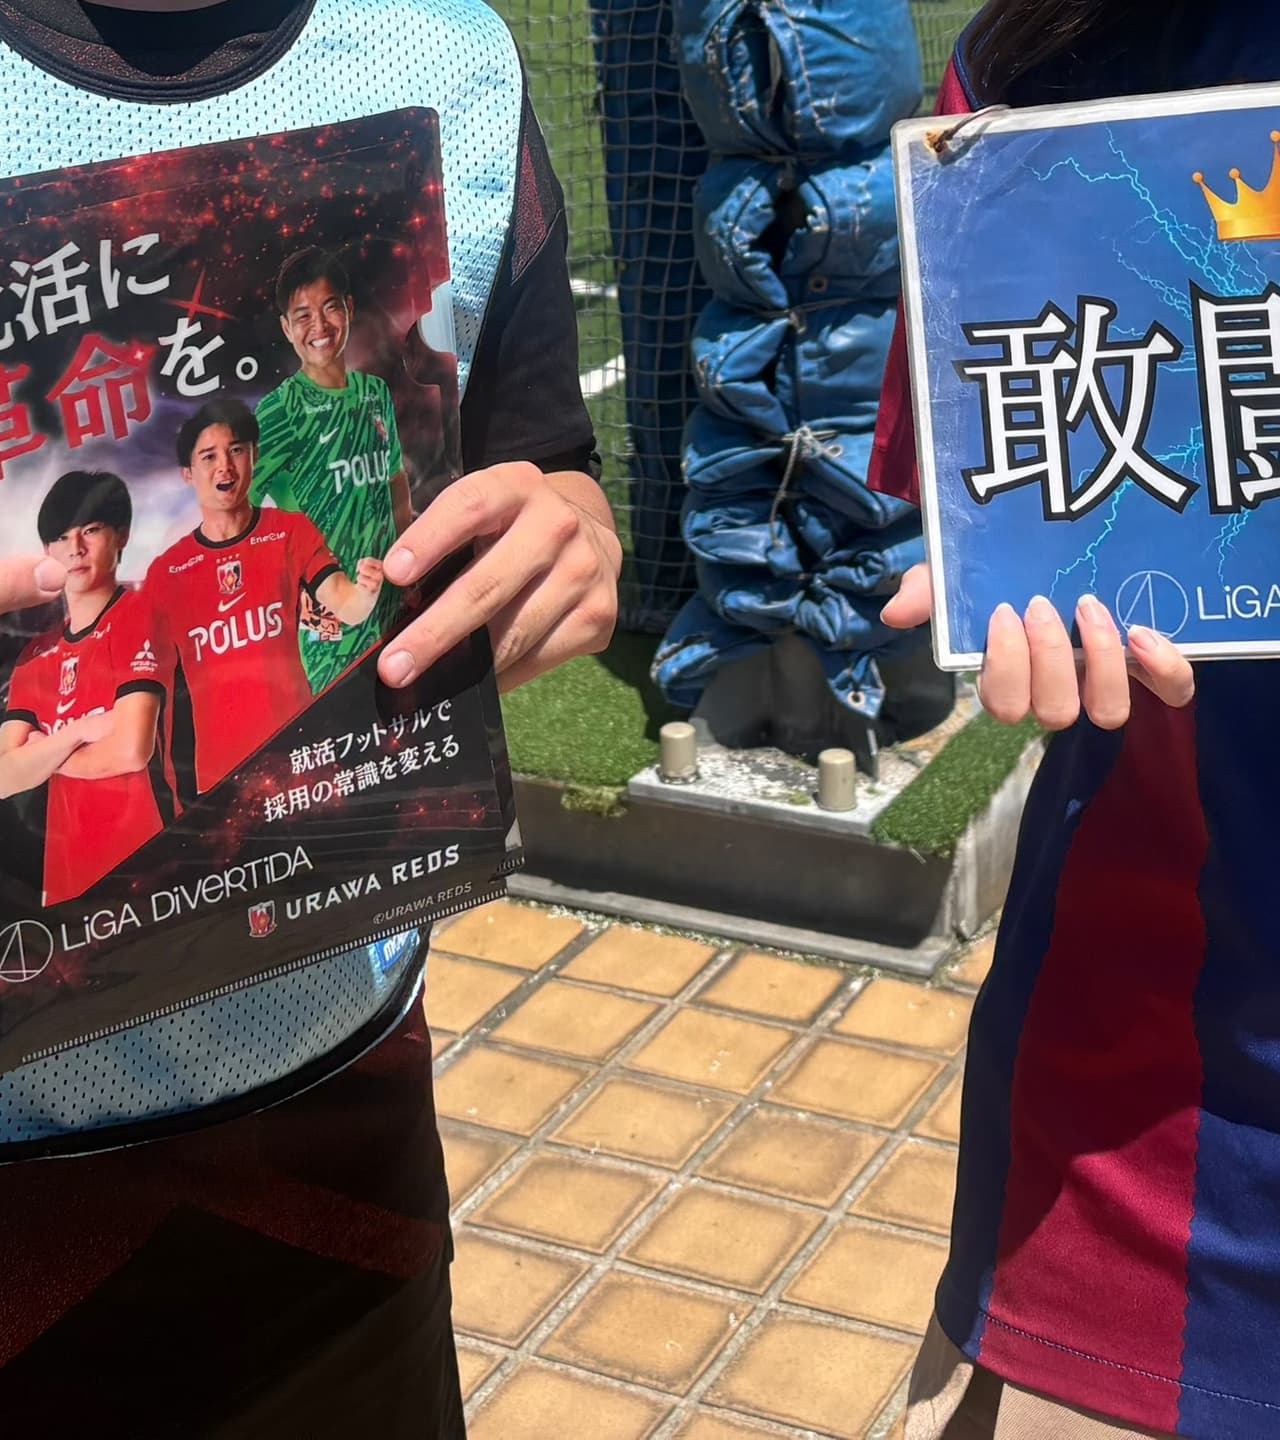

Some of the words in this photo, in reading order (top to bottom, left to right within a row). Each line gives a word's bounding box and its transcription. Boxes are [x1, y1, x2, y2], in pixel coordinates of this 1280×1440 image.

[188, 602, 283, 661] POLUS
[289, 699, 453, 775] 就活フットサルで
[264, 735, 460, 823] 採用の常識を変える
[286, 873, 383, 920] URAWA
[391, 843, 461, 885] REDS
[437, 881, 473, 903] REDS
